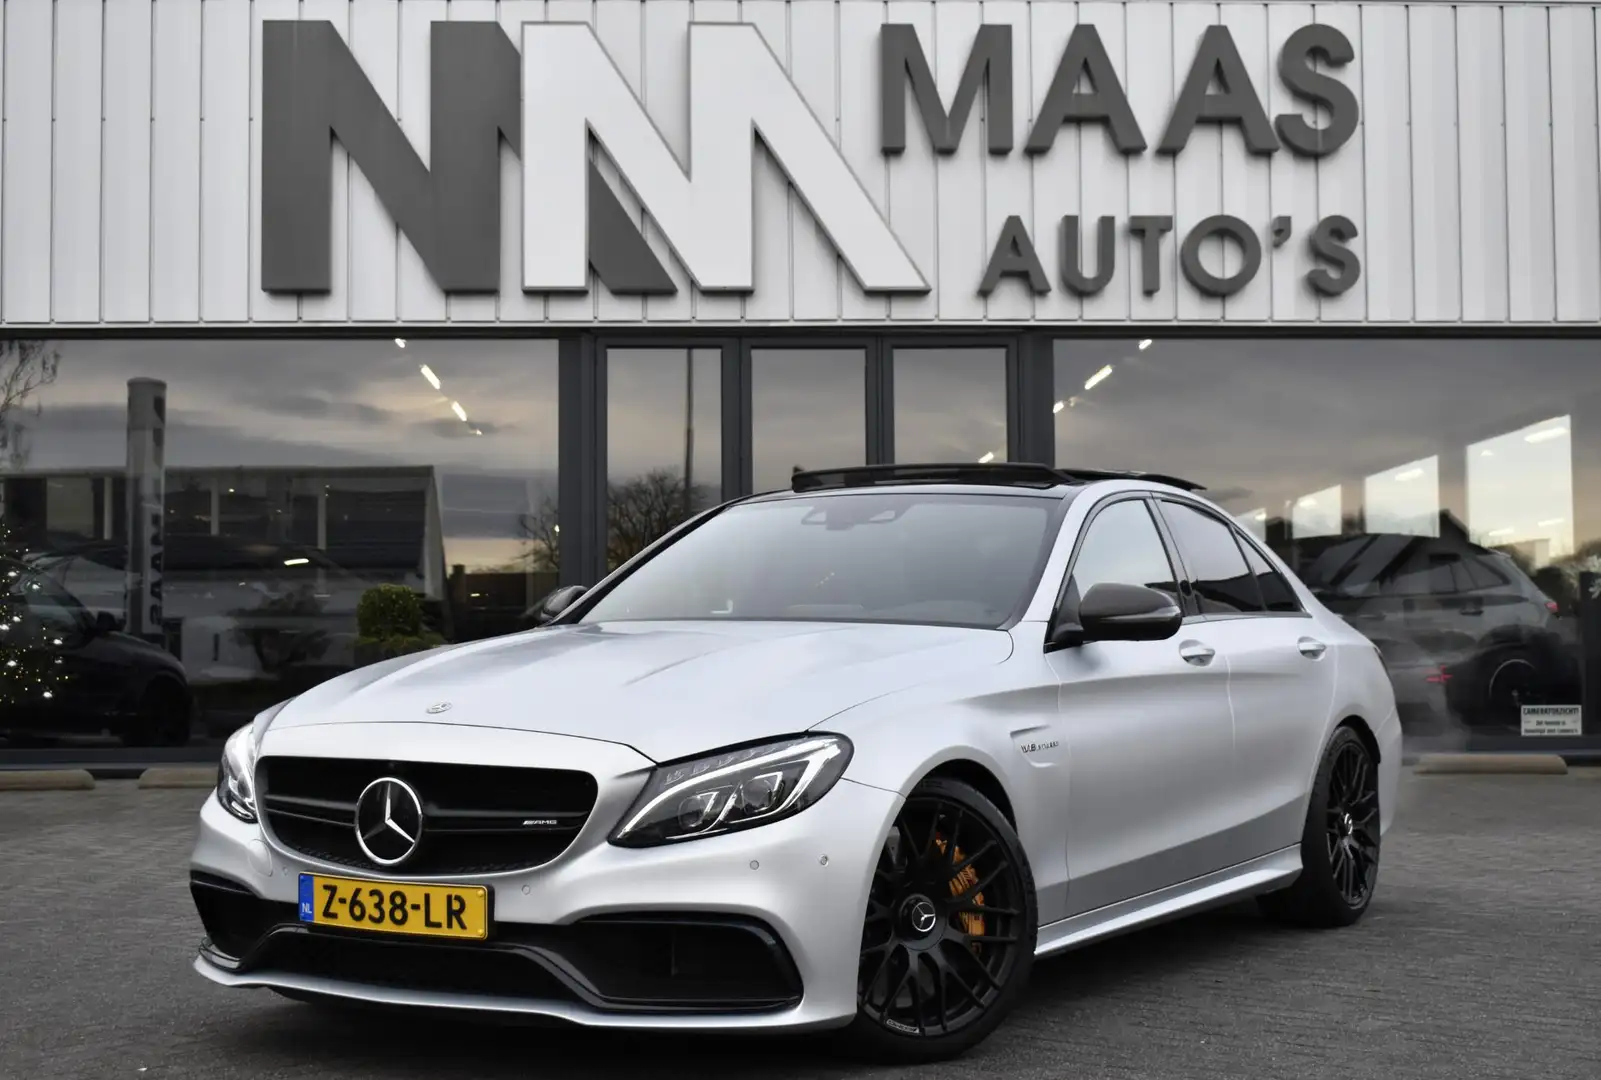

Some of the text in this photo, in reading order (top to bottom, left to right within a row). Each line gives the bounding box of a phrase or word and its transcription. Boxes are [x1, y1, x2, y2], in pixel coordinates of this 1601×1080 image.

[880, 23, 1360, 158] MAAS
[977, 214, 1361, 297] AUTO'S
[301, 902, 312, 914] NL
[322, 884, 467, 930] Z-638-LR
